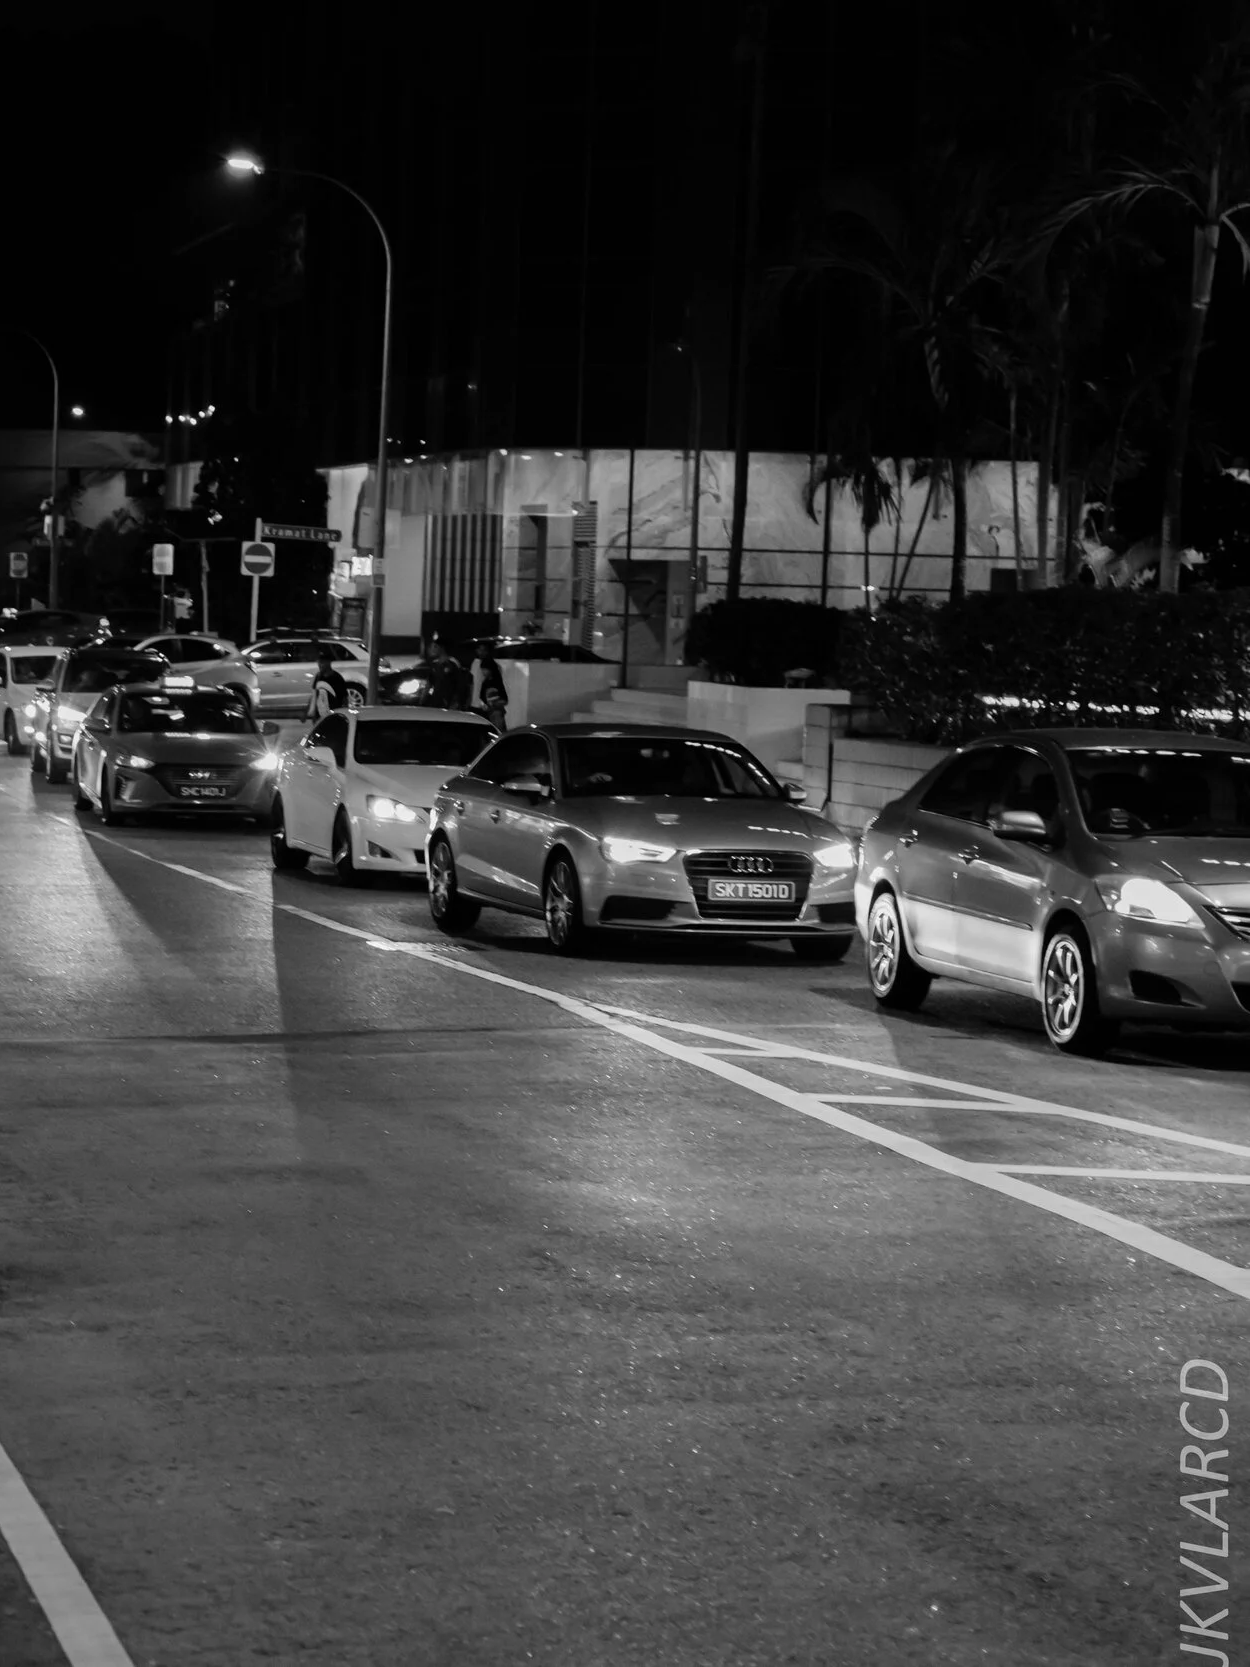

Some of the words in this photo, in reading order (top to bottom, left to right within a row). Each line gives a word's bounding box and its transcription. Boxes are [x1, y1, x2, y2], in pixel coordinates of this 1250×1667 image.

[263, 525, 306, 538] Kramat
[310, 529, 338, 541] Lane
[714, 883, 789, 898] SKT1501D
